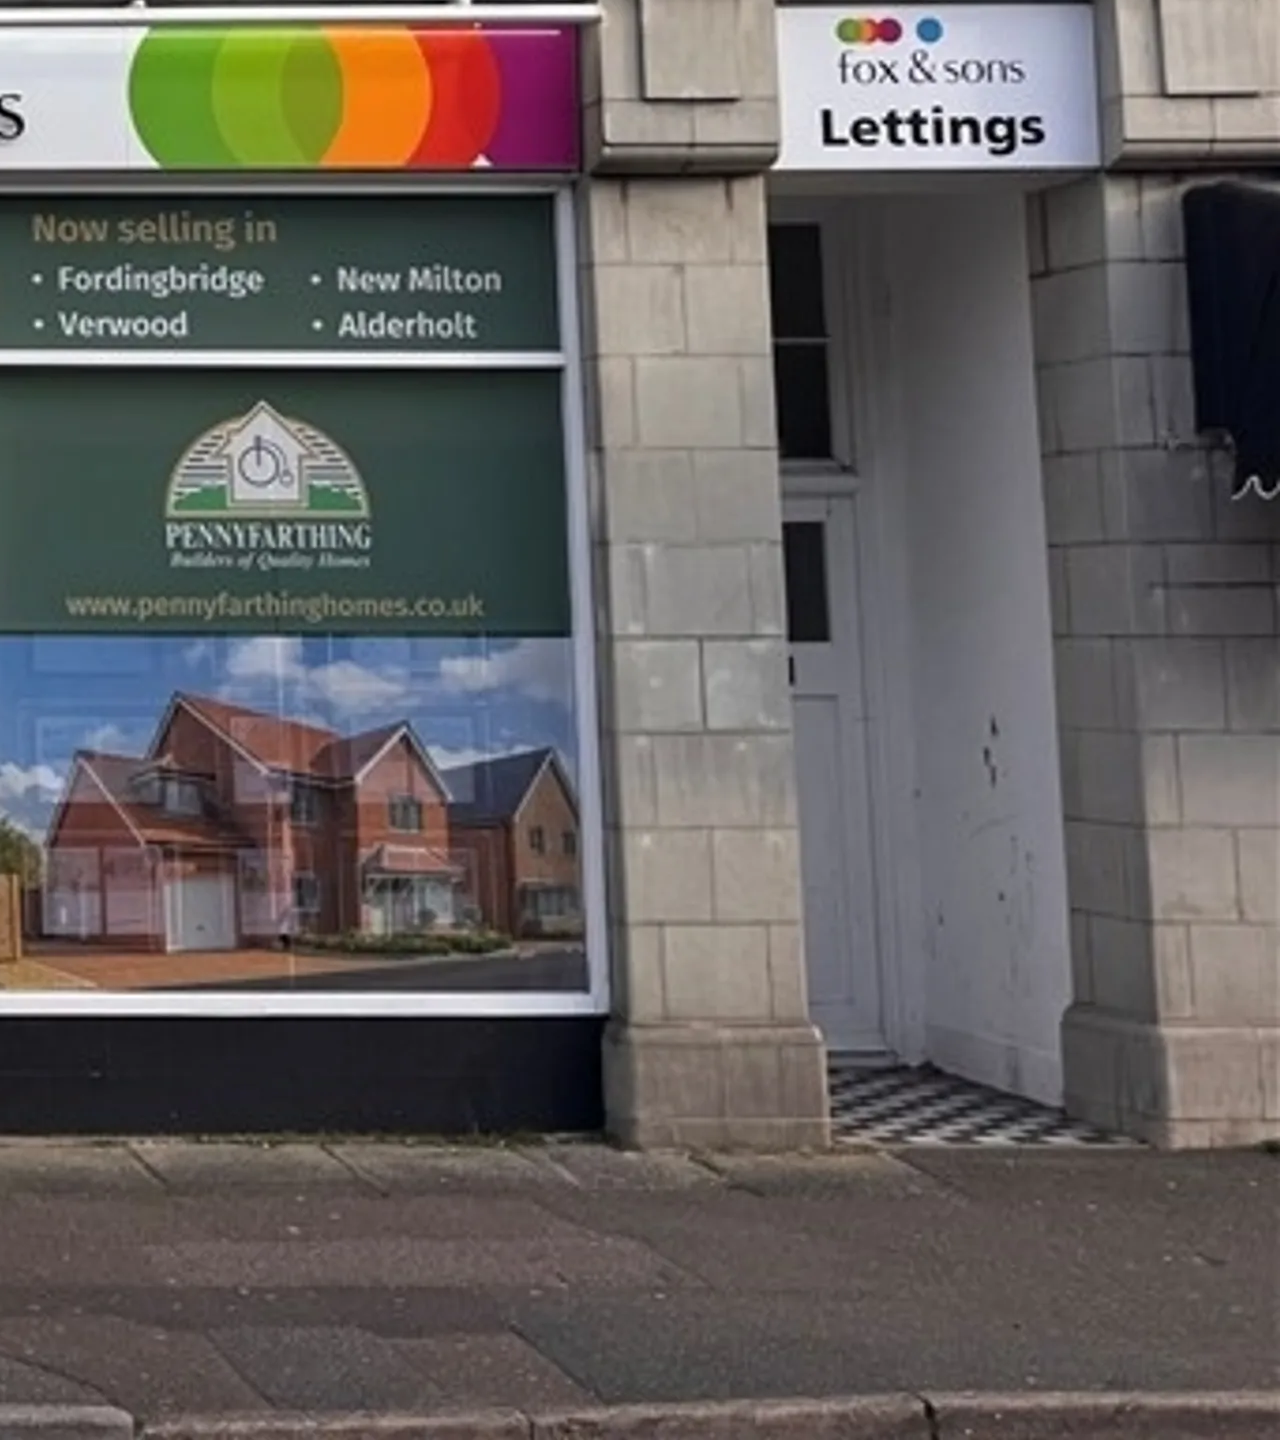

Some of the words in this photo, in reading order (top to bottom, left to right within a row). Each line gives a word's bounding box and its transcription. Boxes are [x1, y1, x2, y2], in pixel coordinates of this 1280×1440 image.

[838, 51, 899, 85] fox
[908, 50, 937, 85] &
[945, 57, 1027, 84] sons
[820, 107, 1046, 156] Lettings
[32, 214, 109, 243] Now
[117, 212, 236, 251] selling
[244, 213, 278, 243] in
[57, 265, 265, 299] Fordingbridge
[336, 266, 401, 293] New
[409, 263, 502, 293] Milton
[57, 311, 188, 338] Verwood
[338, 310, 478, 338] Alderholt
[165, 522, 372, 549] PENNYFARTHING
[65, 591, 484, 621] www.pennyfarthinghomes.co.uk
